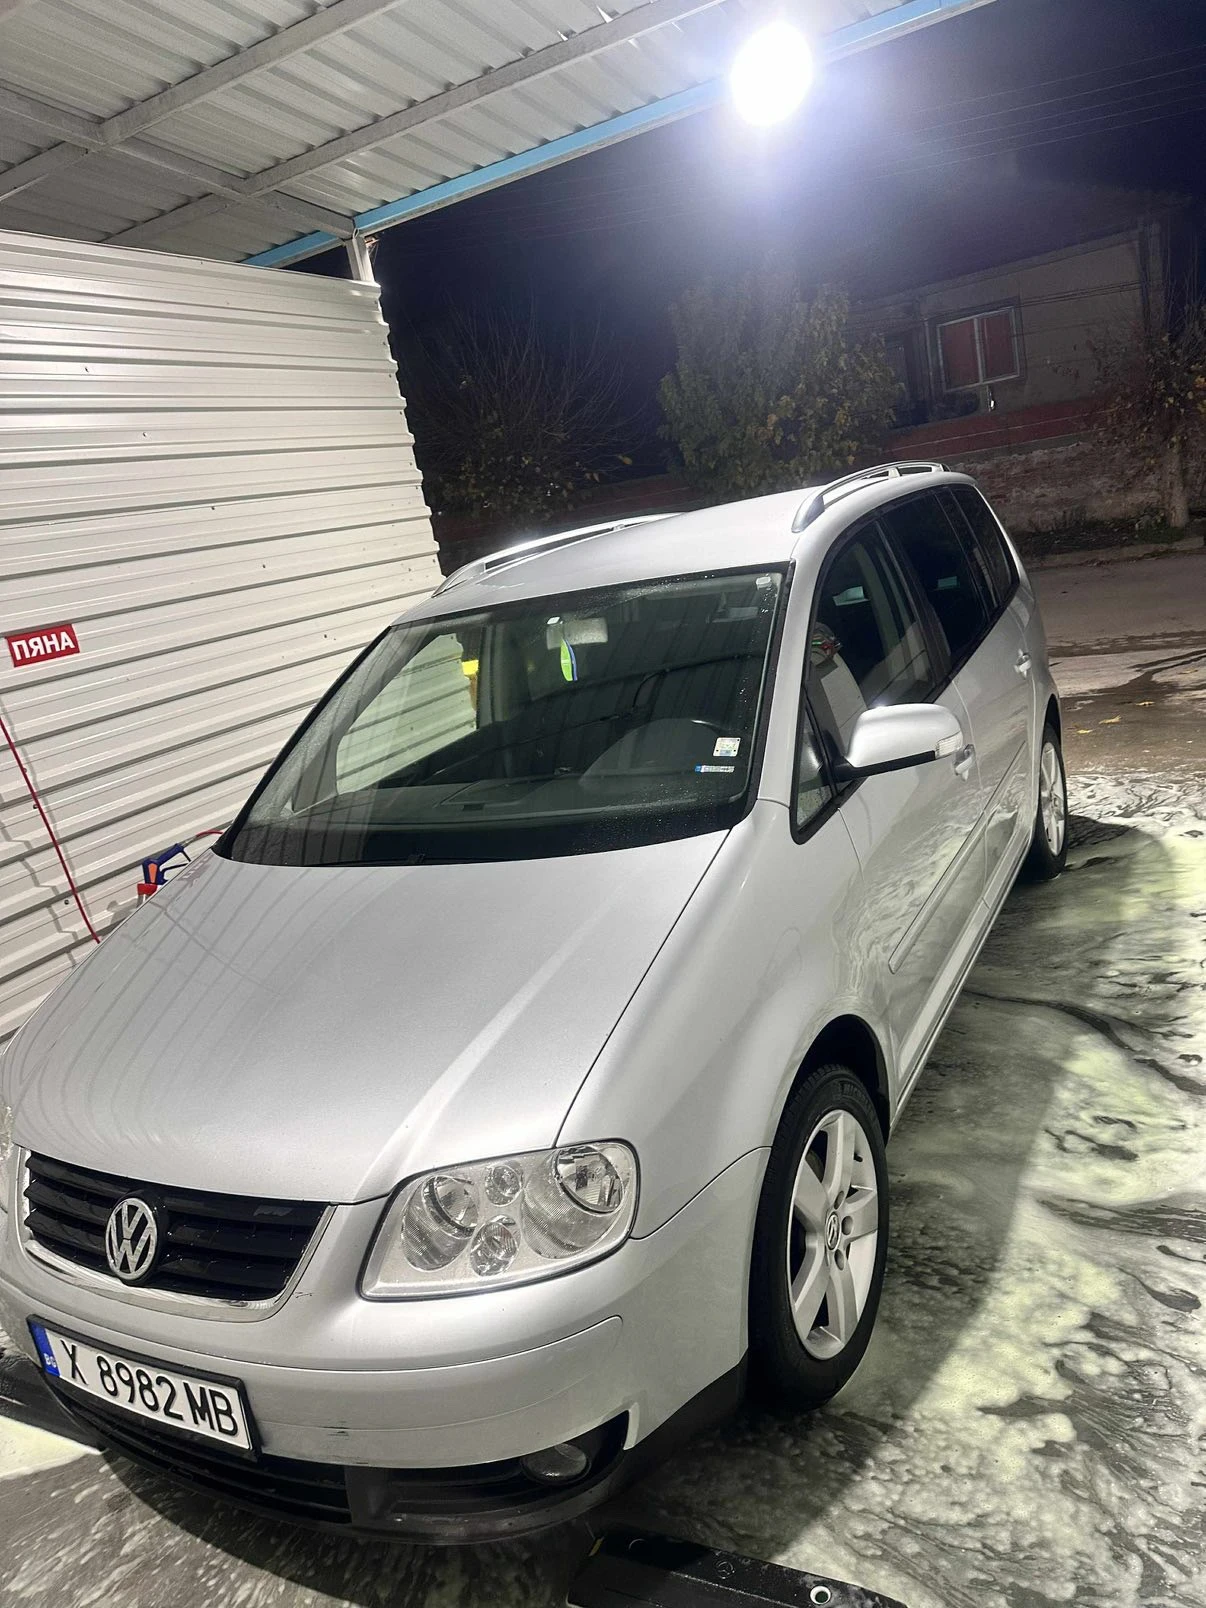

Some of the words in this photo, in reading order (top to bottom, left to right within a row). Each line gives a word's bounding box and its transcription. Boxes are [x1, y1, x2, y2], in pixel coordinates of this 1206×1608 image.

[11, 631, 76, 661] ПЯНА
[106, 1198, 157, 1280] VW
[60, 1339, 88, 1386] X
